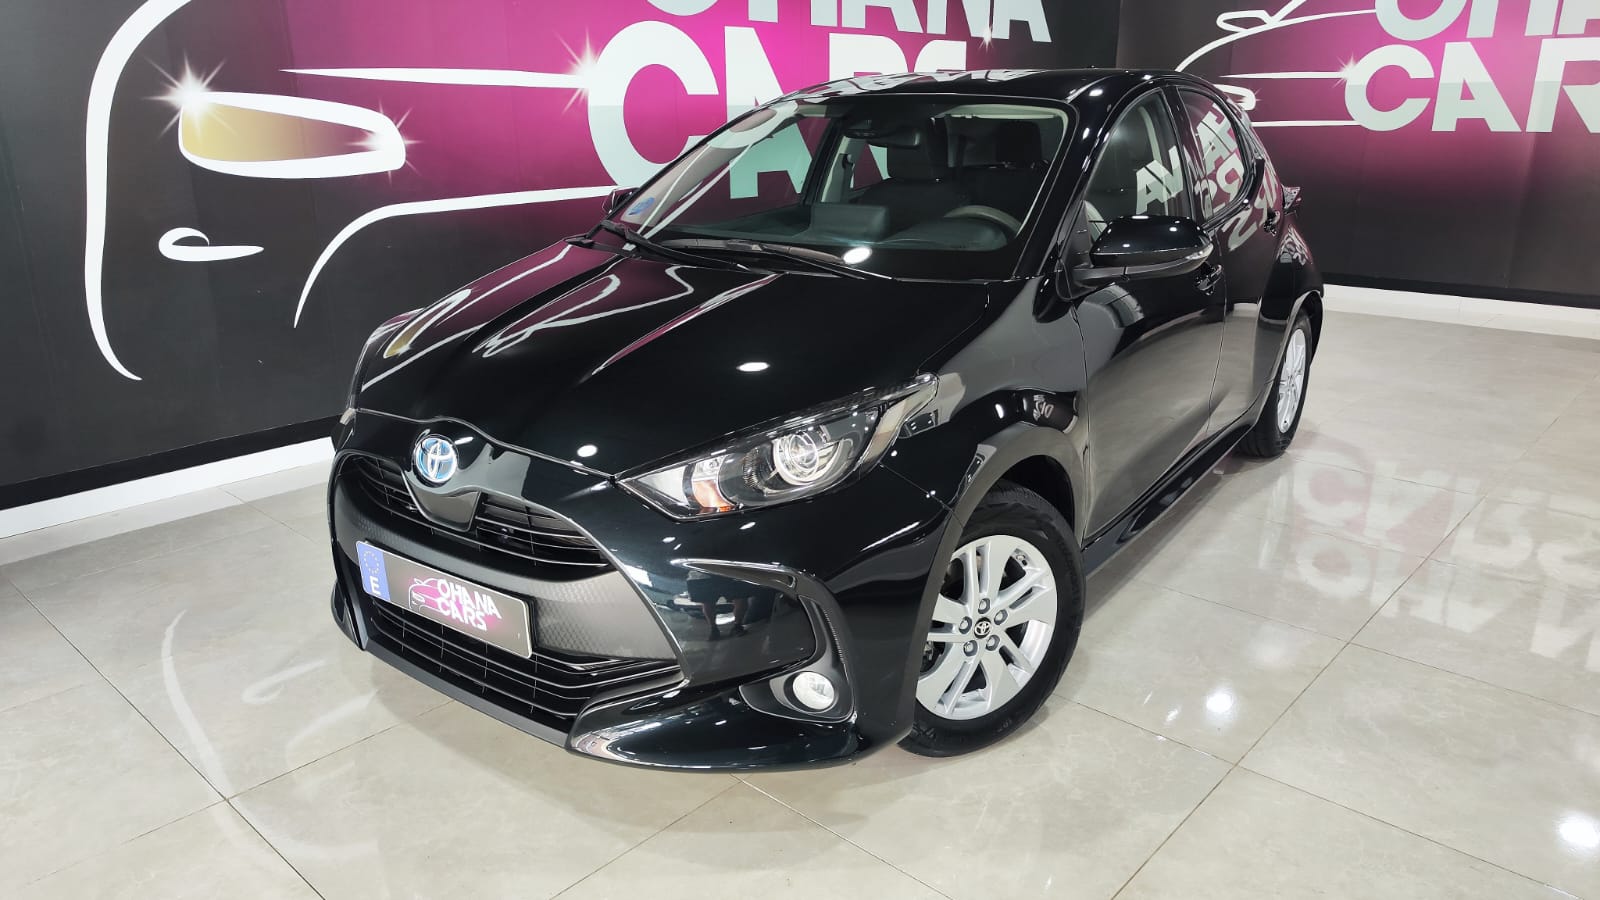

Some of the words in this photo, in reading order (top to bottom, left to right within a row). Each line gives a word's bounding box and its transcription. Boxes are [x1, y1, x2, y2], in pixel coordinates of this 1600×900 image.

[370, 575, 382, 596] E
[437, 578, 502, 619] OHANA
[436, 597, 488, 631] CARS
